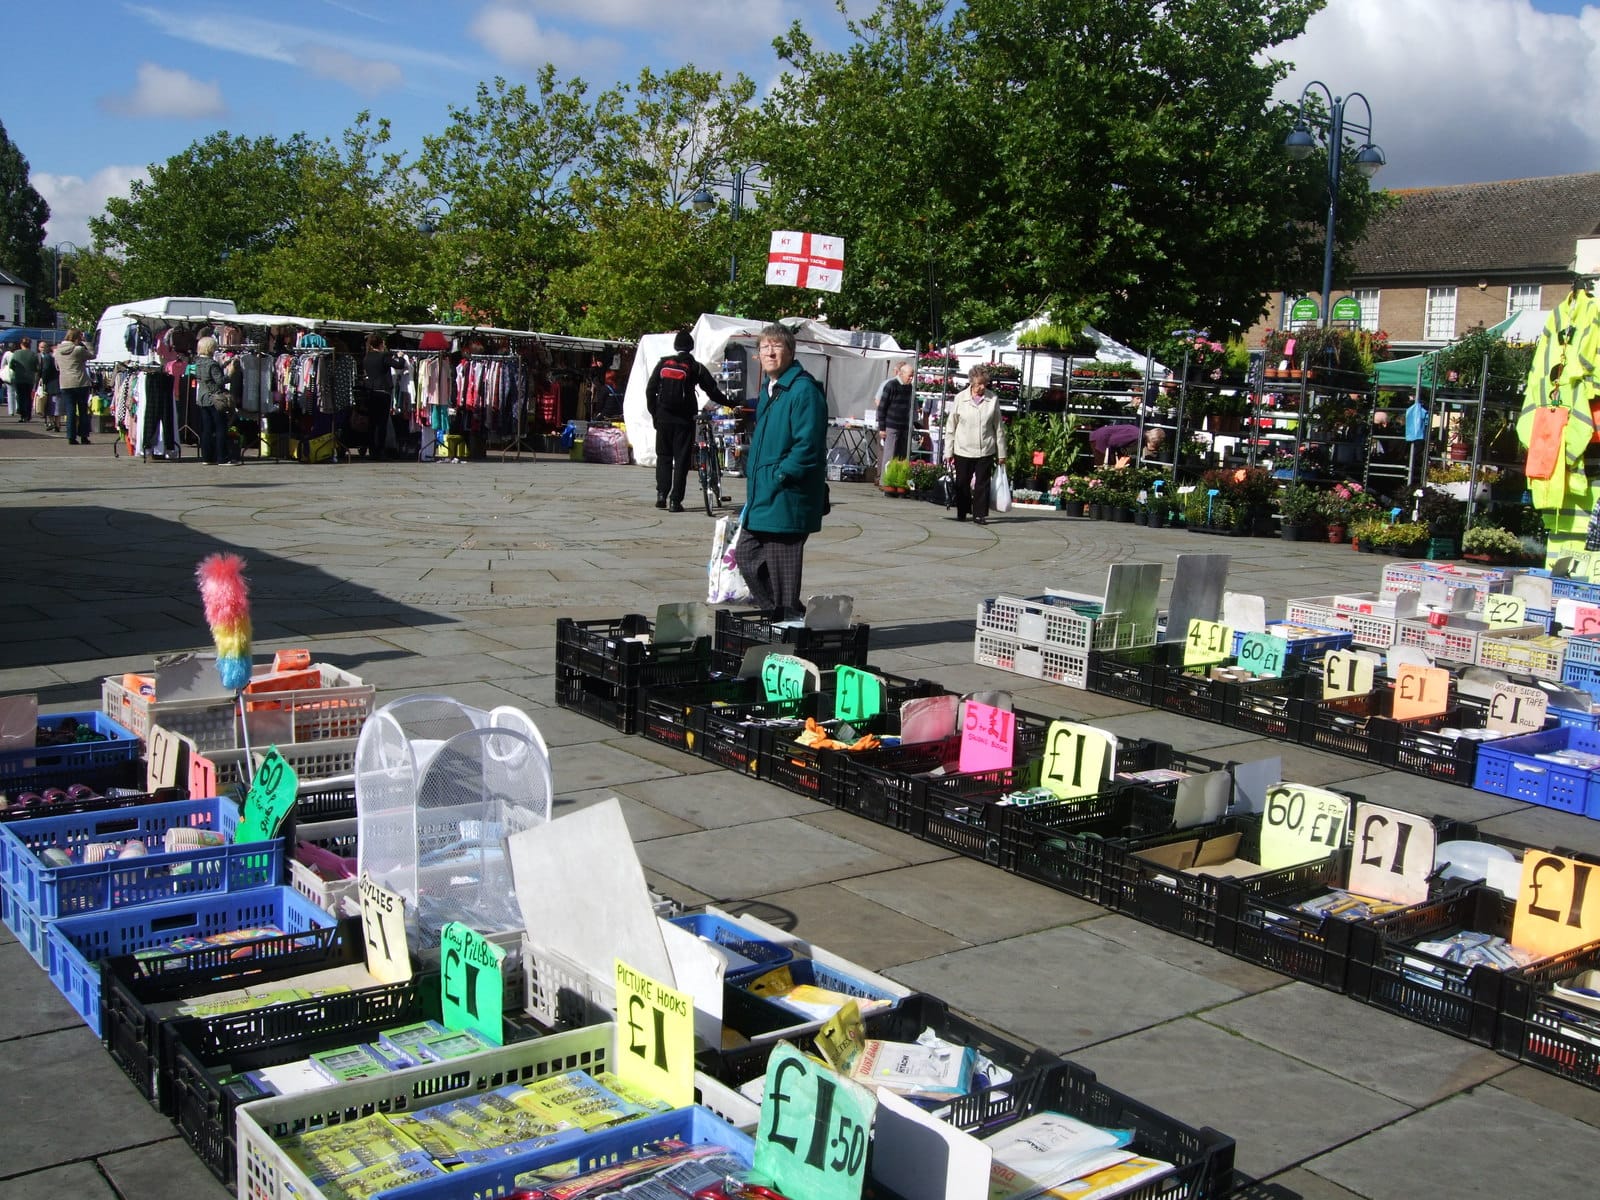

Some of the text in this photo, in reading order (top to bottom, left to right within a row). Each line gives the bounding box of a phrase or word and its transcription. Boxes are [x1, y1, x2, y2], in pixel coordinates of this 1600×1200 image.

[1489, 602, 1518, 623] £2
[1208, 624, 1229, 653] £1
[1263, 653, 1279, 671] £1
[841, 669, 864, 719] £1
[1326, 655, 1358, 692] £1
[1400, 674, 1426, 702] £1
[1491, 693, 1521, 724] £1
[1525, 697, 1545, 707] TAPE
[152, 733, 168, 784] £1
[1048, 729, 1086, 788] £1
[1310, 813, 1342, 847] £1
[1362, 814, 1412, 875] £1
[1528, 856, 1592, 928] £1
[364, 899, 392, 961] £1
[444, 948, 480, 1021] £1
[617, 964, 687, 1017] PICTURE HOOKS
[628, 994, 669, 1073] £1
[768, 1057, 865, 1177] £1.50
